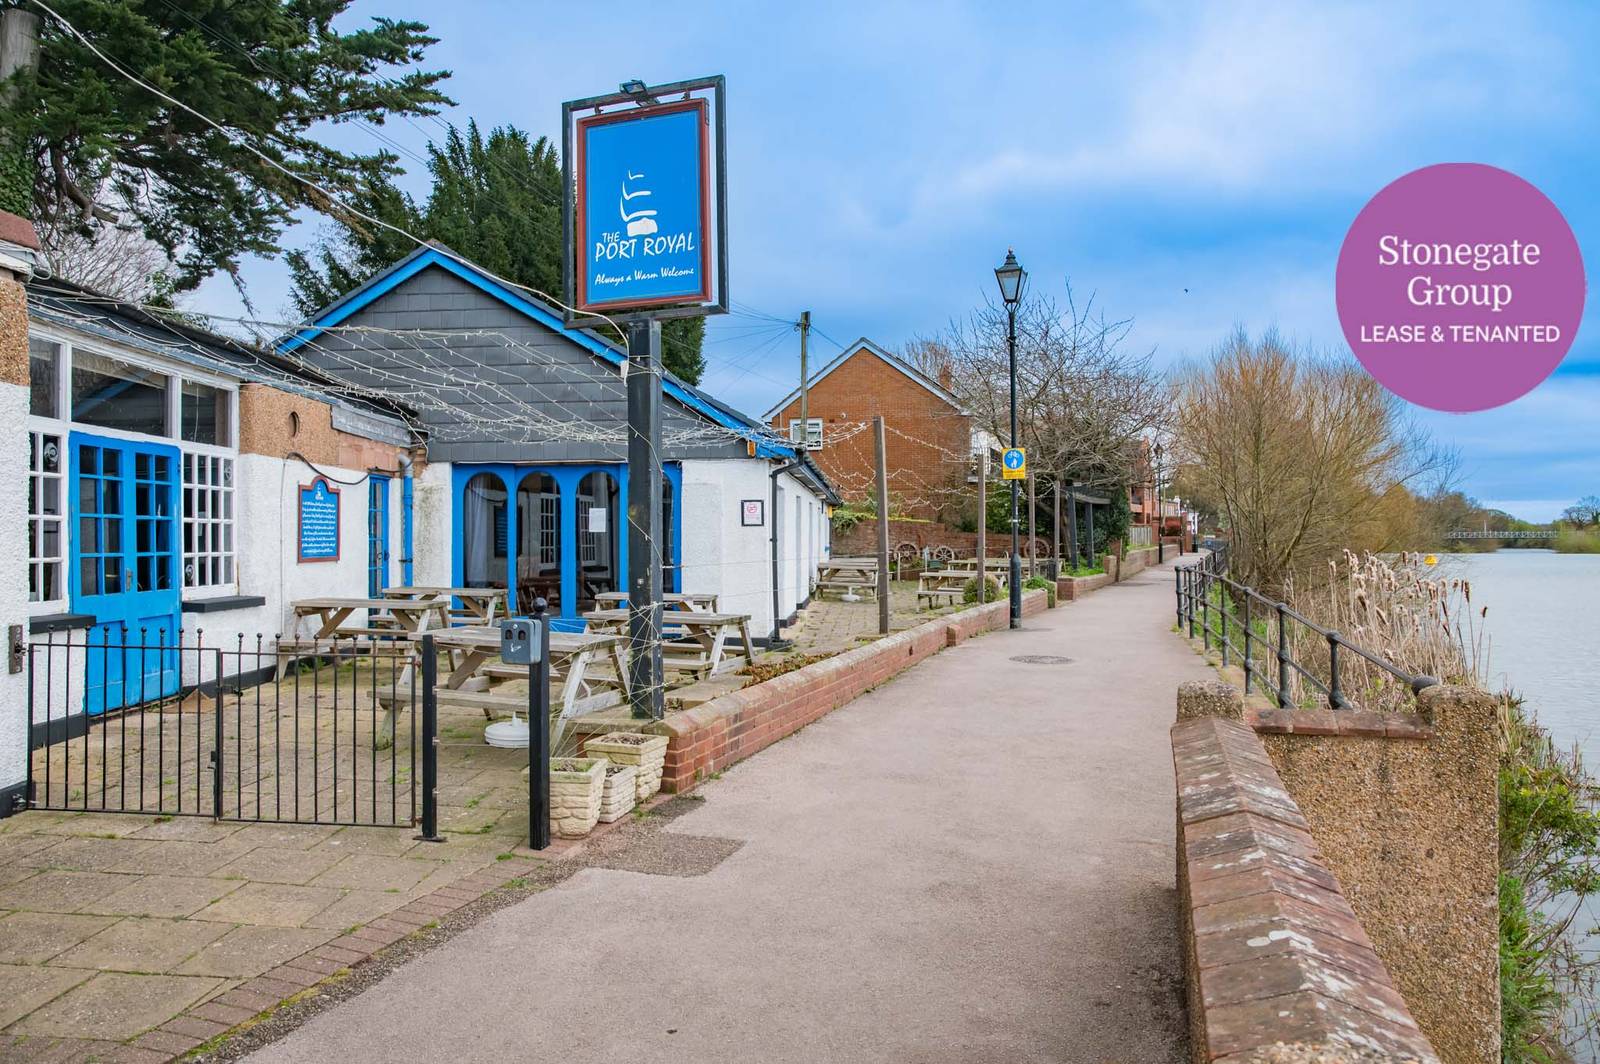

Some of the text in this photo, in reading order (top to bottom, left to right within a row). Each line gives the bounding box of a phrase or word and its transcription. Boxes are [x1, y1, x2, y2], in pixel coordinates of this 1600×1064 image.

[595, 232, 695, 262] PORT ROYAL
[602, 232, 620, 243] THE
[595, 273, 625, 286] Always
[634, 270, 658, 281] Warm
[660, 266, 694, 277] Welcome
